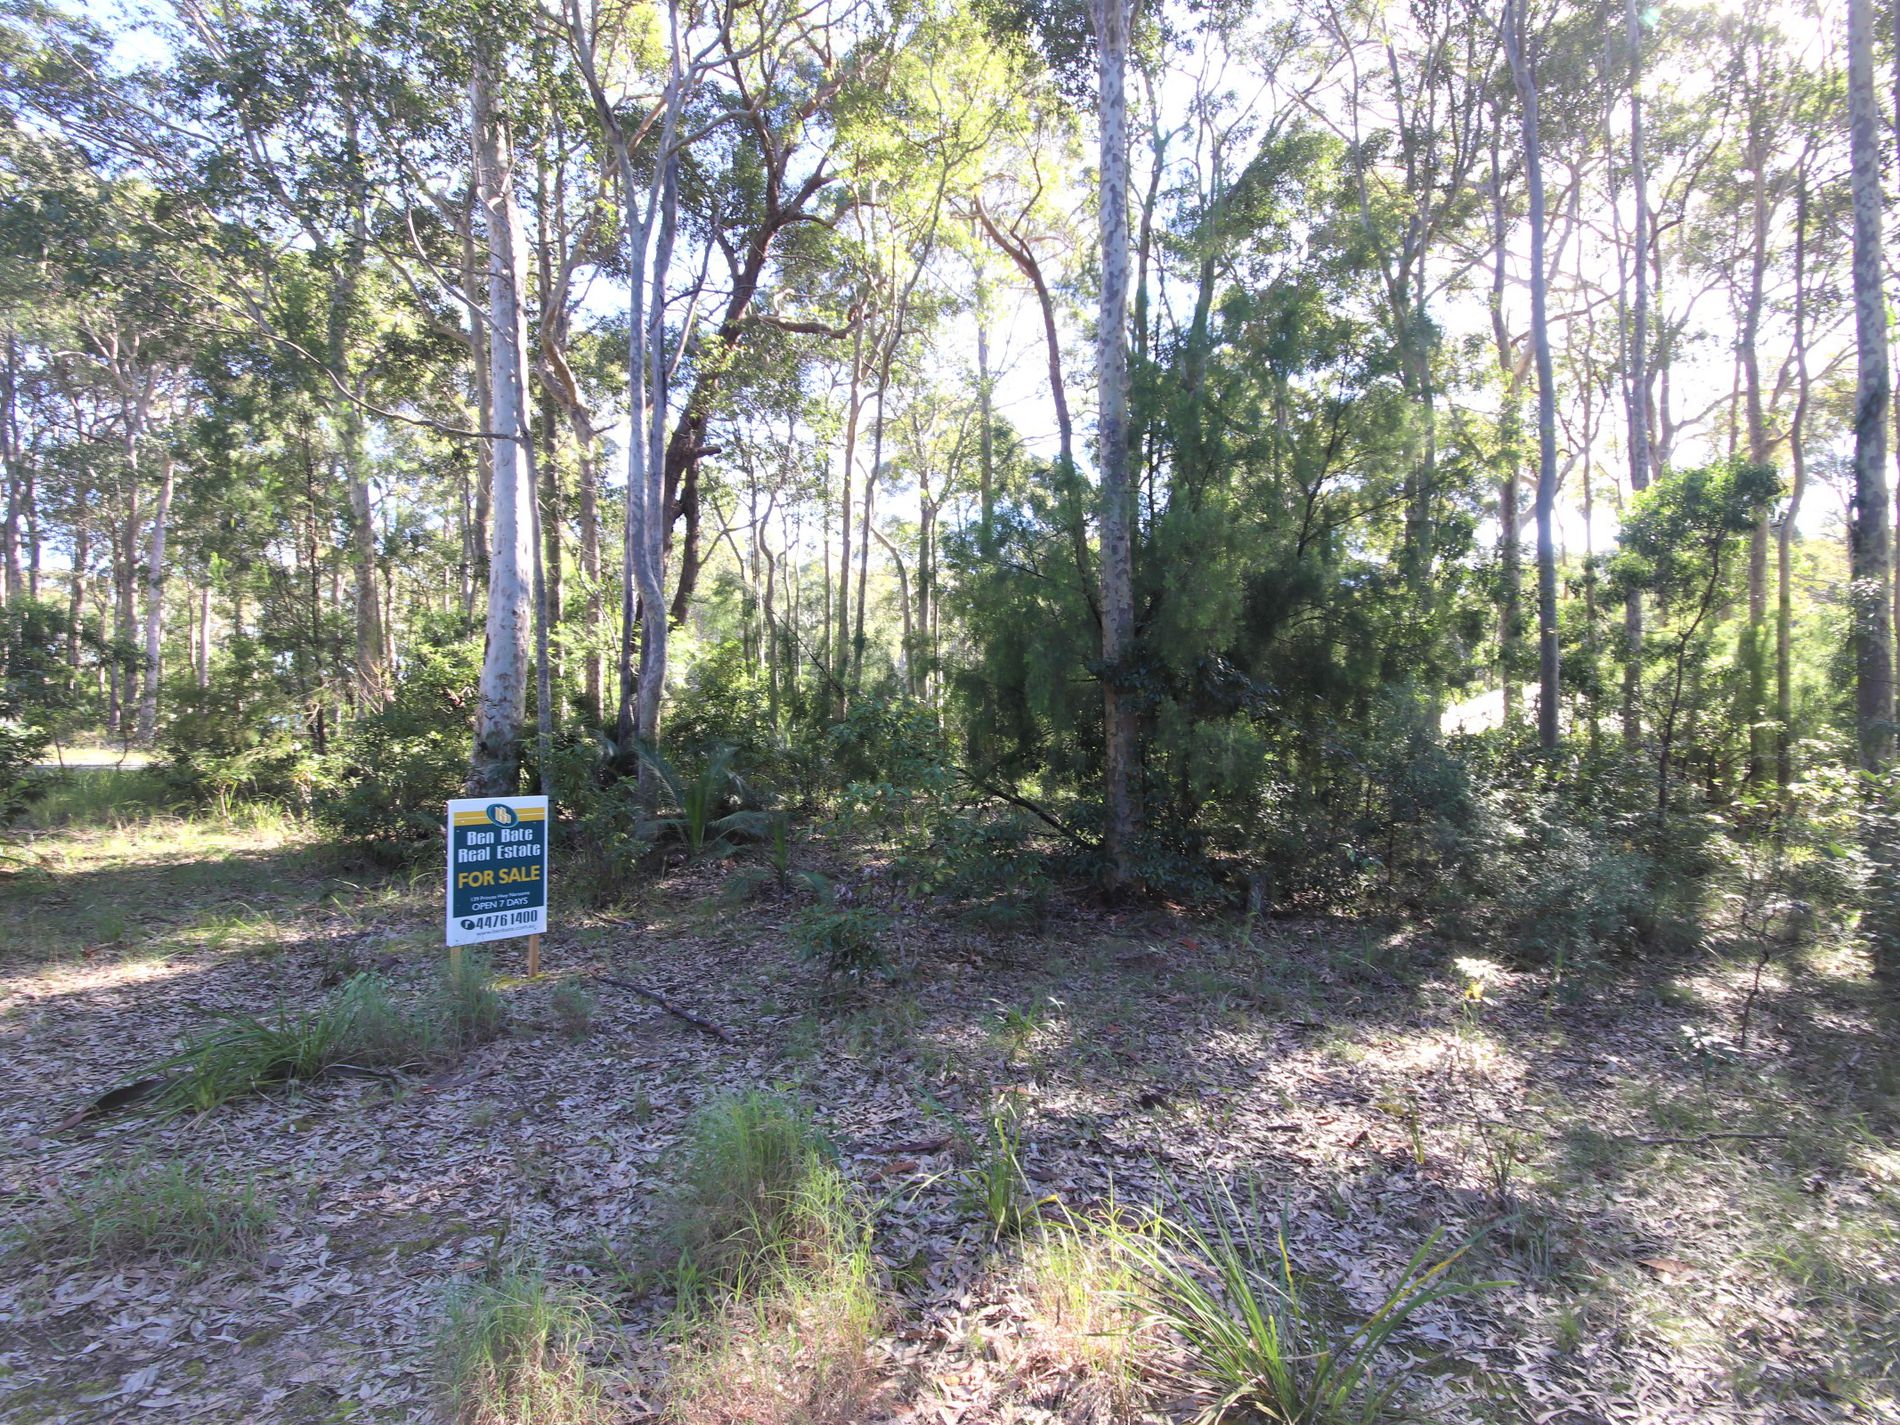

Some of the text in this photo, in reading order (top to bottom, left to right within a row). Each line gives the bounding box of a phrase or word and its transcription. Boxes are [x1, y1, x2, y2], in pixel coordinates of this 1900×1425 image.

[467, 828, 533, 846] Ben Bate
[458, 844, 541, 863] Real Estate
[458, 865, 541, 889] FOR SALE
[472, 896, 529, 911] OPEN 7 DAYS
[476, 909, 538, 929] 4476 1400
